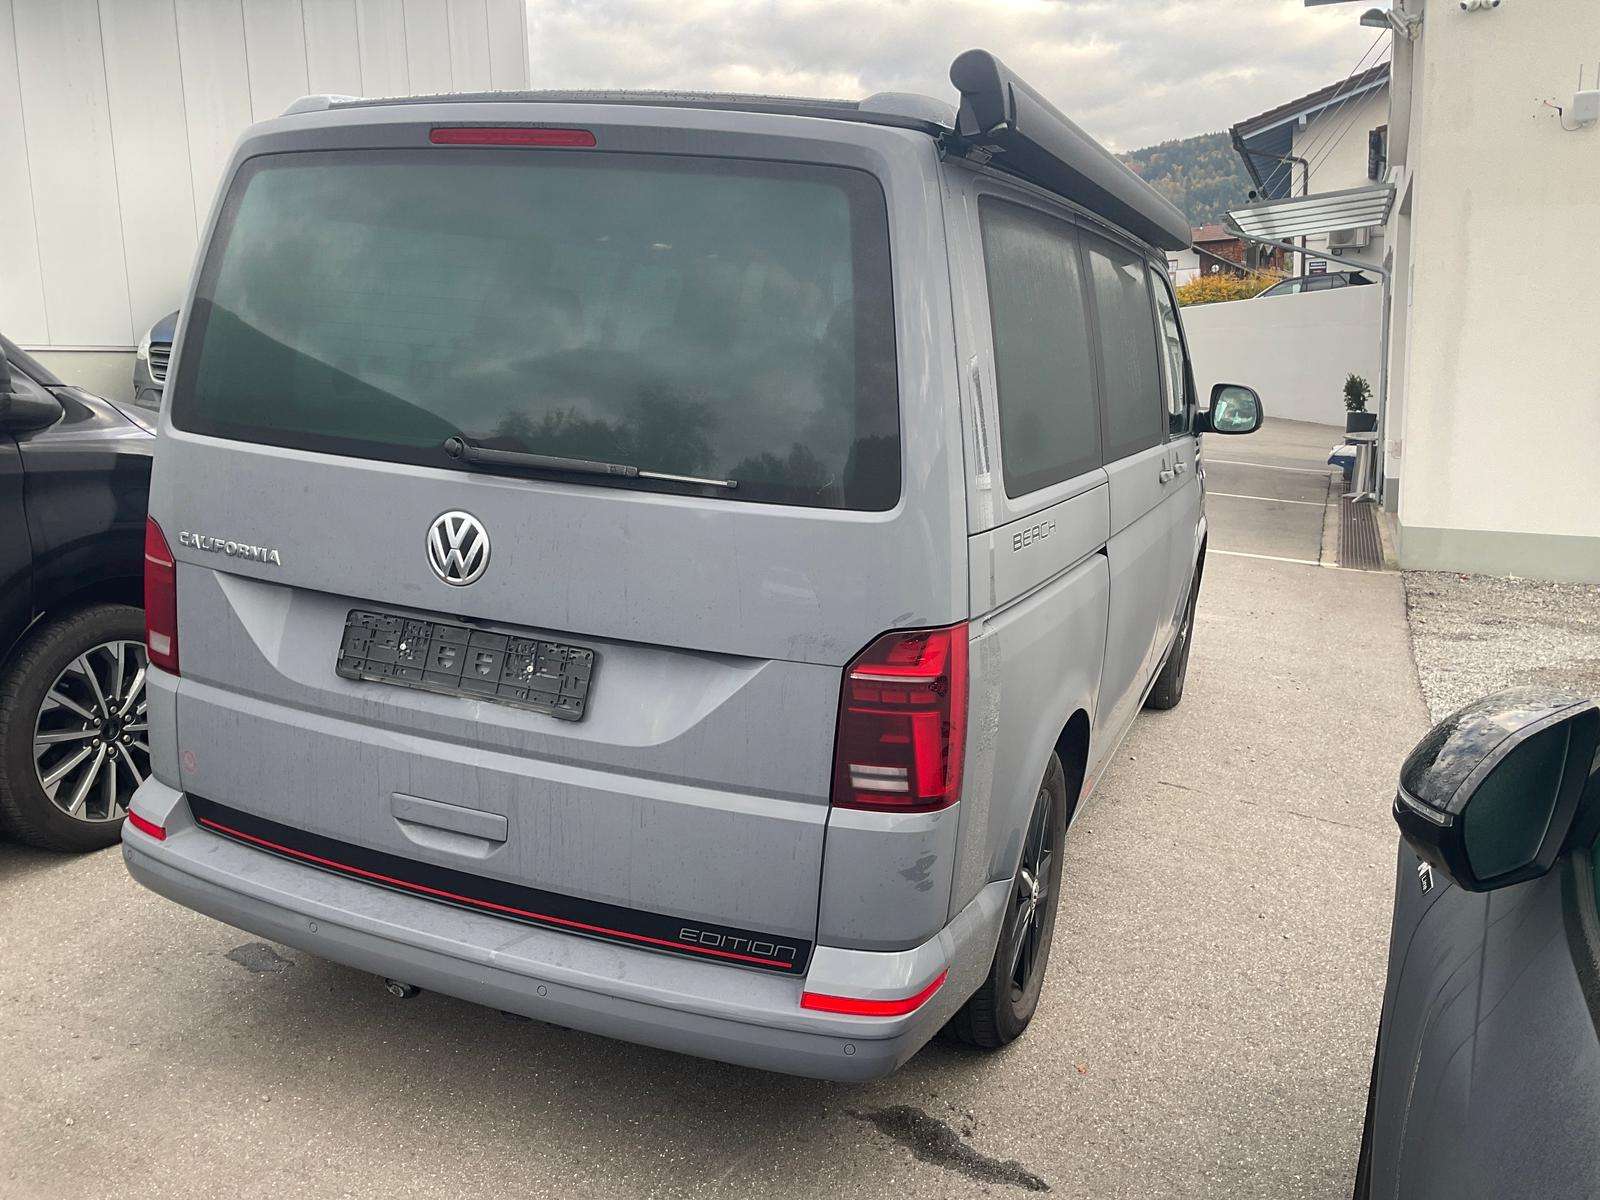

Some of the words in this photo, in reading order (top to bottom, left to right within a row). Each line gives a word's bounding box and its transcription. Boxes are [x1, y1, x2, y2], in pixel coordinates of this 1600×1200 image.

[178, 530, 281, 566] CALIFORNIA
[428, 512, 488, 584] VW
[1013, 520, 1056, 552] BEACH
[679, 927, 797, 960] EDITION
